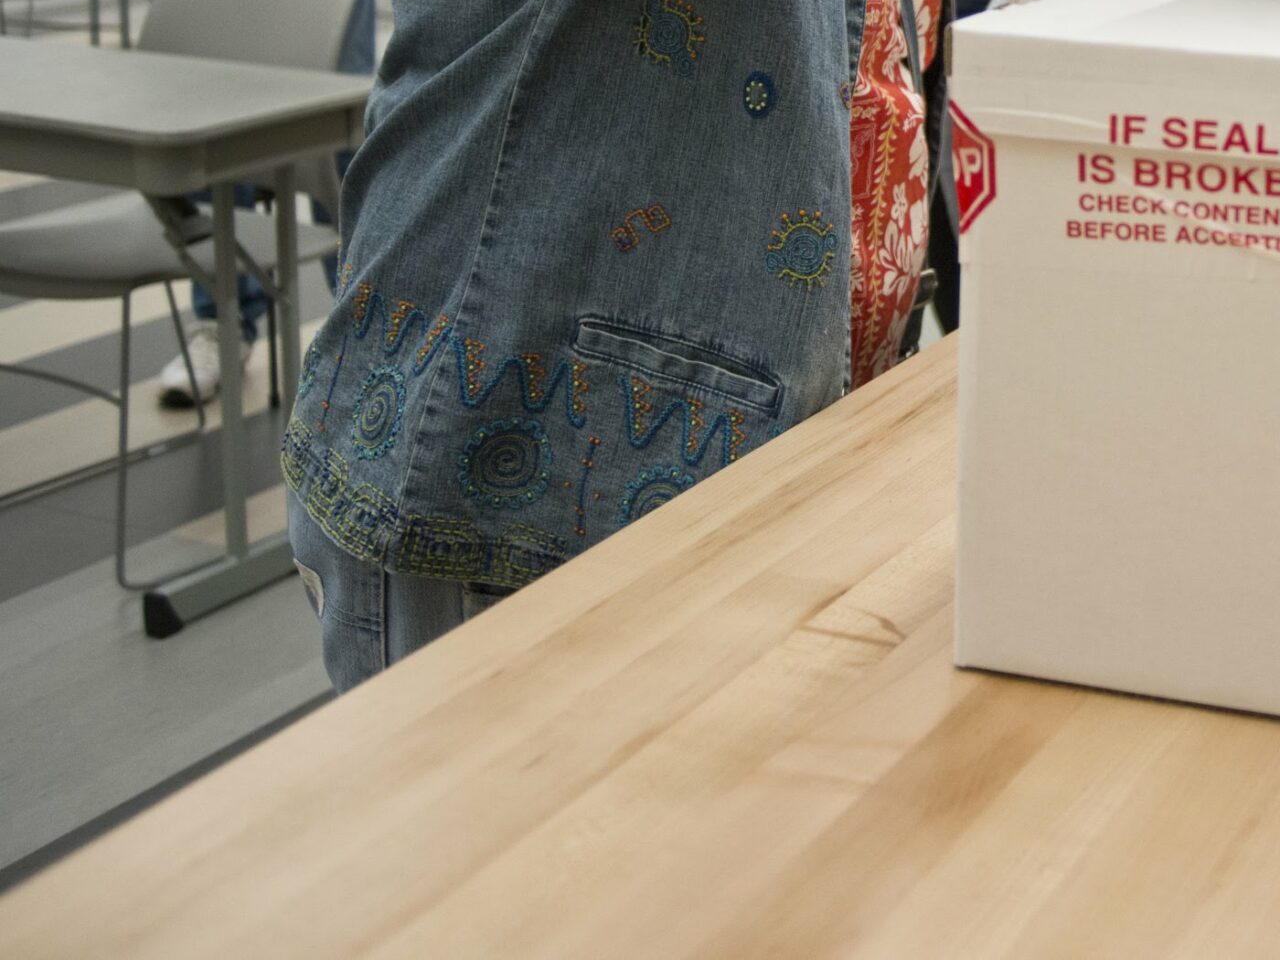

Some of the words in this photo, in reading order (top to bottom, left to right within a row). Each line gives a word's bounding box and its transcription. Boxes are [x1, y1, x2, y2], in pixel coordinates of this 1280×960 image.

[1109, 113, 1147, 145] IF
[1163, 117, 1279, 156] SEAL
[1077, 153, 1116, 185] IS
[1079, 194, 1165, 214] CHECK
[1066, 220, 1165, 243] BEFORE
